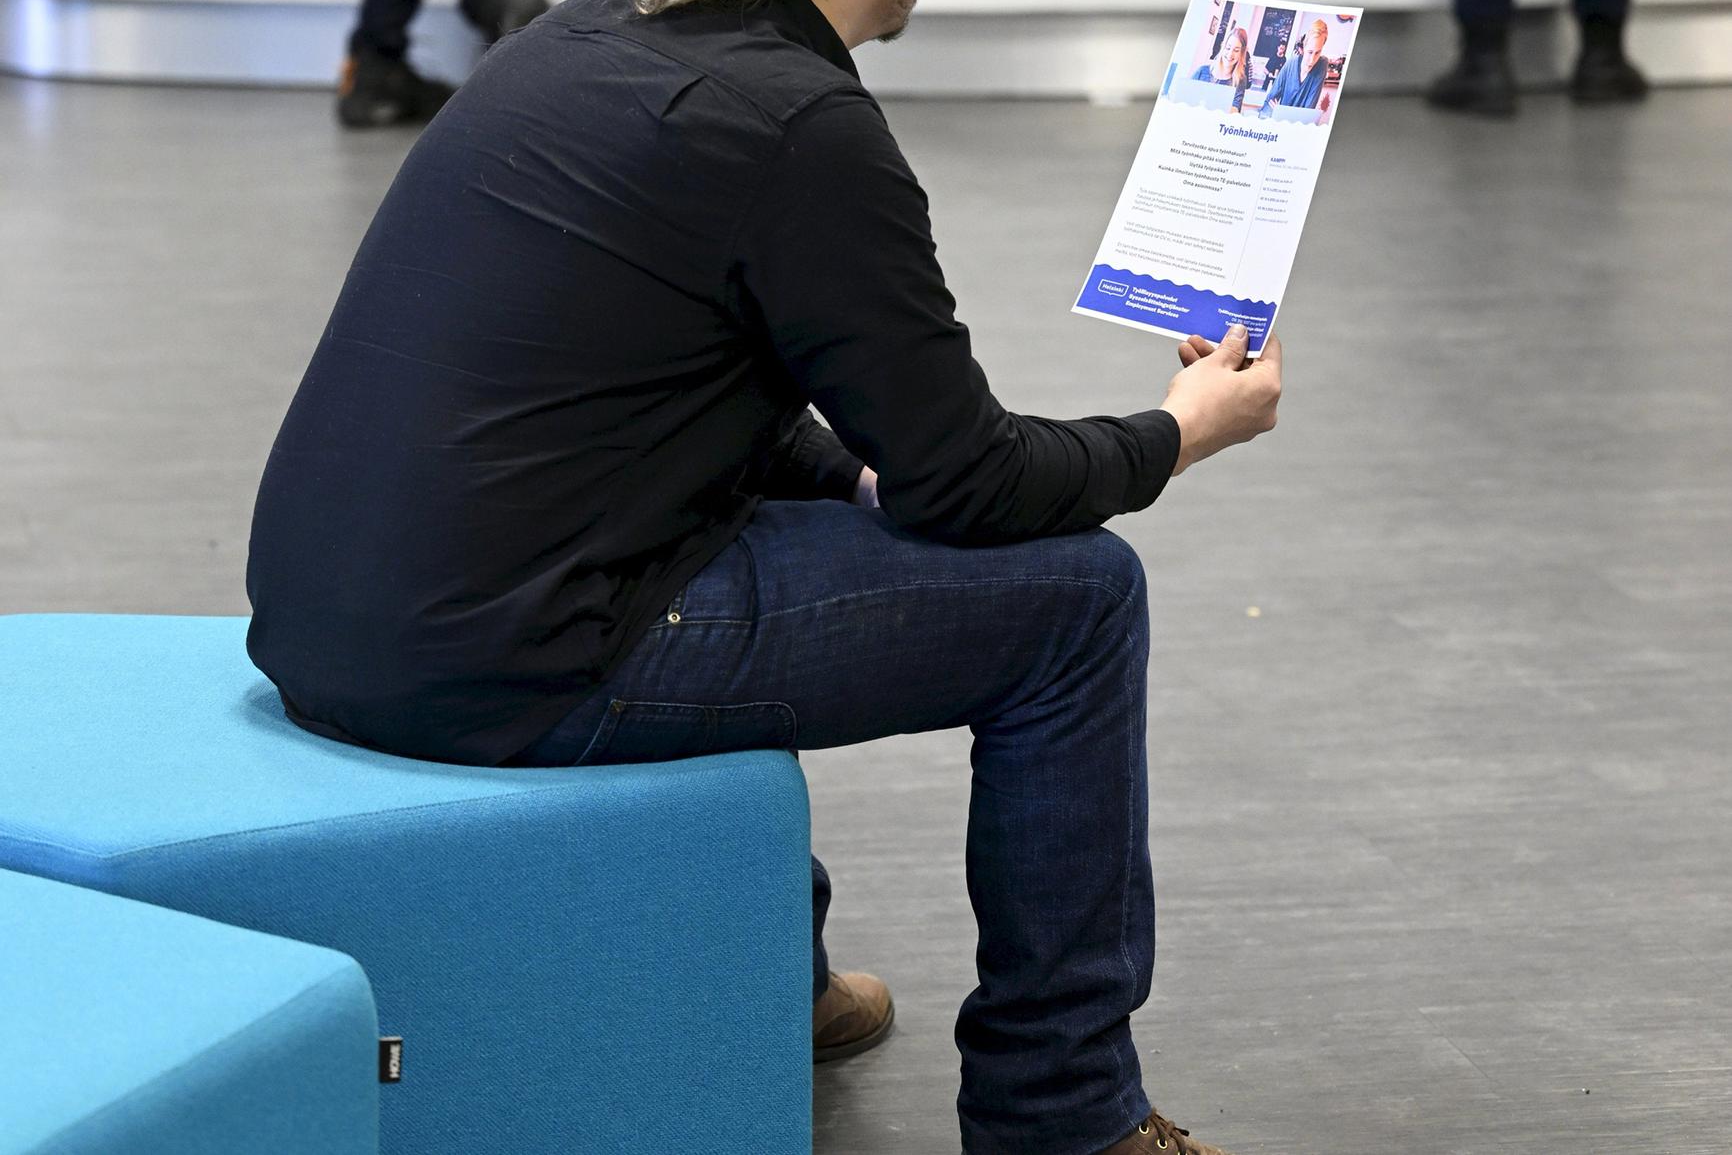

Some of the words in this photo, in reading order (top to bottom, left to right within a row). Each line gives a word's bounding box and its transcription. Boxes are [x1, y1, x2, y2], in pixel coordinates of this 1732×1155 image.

[1219, 124, 1278, 142] Työnhakupajat
[1102, 283, 1124, 293] Helsinki
[1125, 300, 1156, 313] Employment
[1156, 308, 1179, 318] Services
